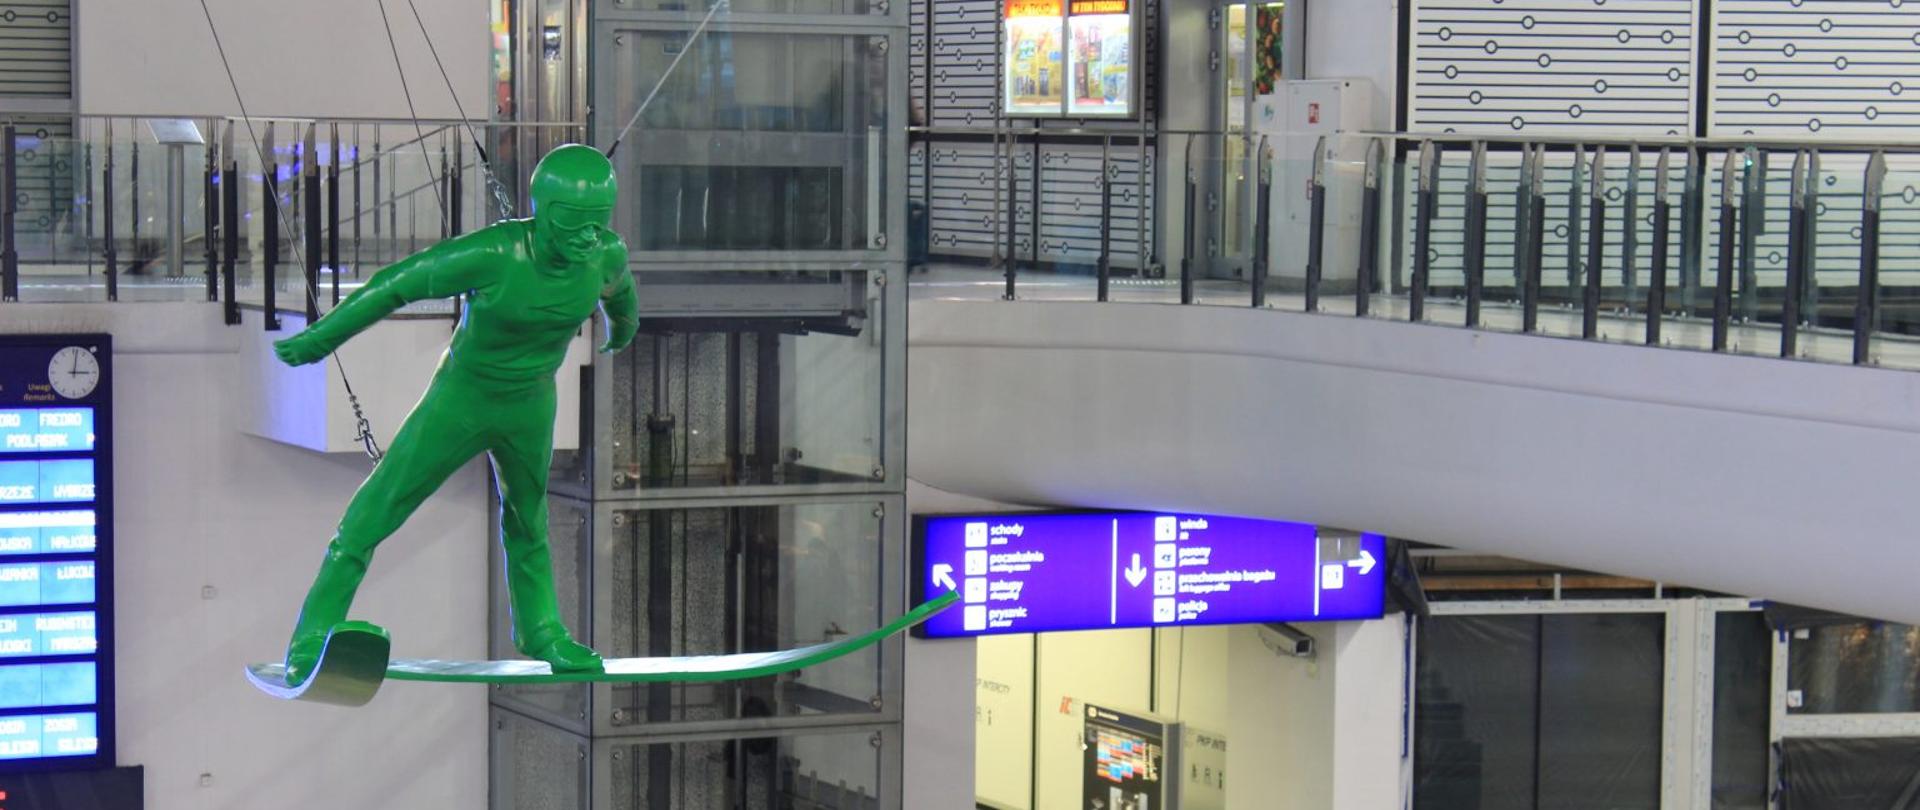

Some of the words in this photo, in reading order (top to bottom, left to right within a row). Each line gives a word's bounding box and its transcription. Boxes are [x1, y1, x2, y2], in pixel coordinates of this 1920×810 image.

[991, 524, 1023, 536] schody
[1180, 519, 1207, 529] winda
[990, 552, 1044, 564] poczekalnia
[1179, 548, 1210, 558] perony
[1179, 571, 1242, 584] przechowalnia
[990, 580, 1023, 592] zakupy
[1179, 601, 1207, 612] policja
[989, 607, 1027, 620] prysznic
[982, 679, 1011, 694] INTERCITY
